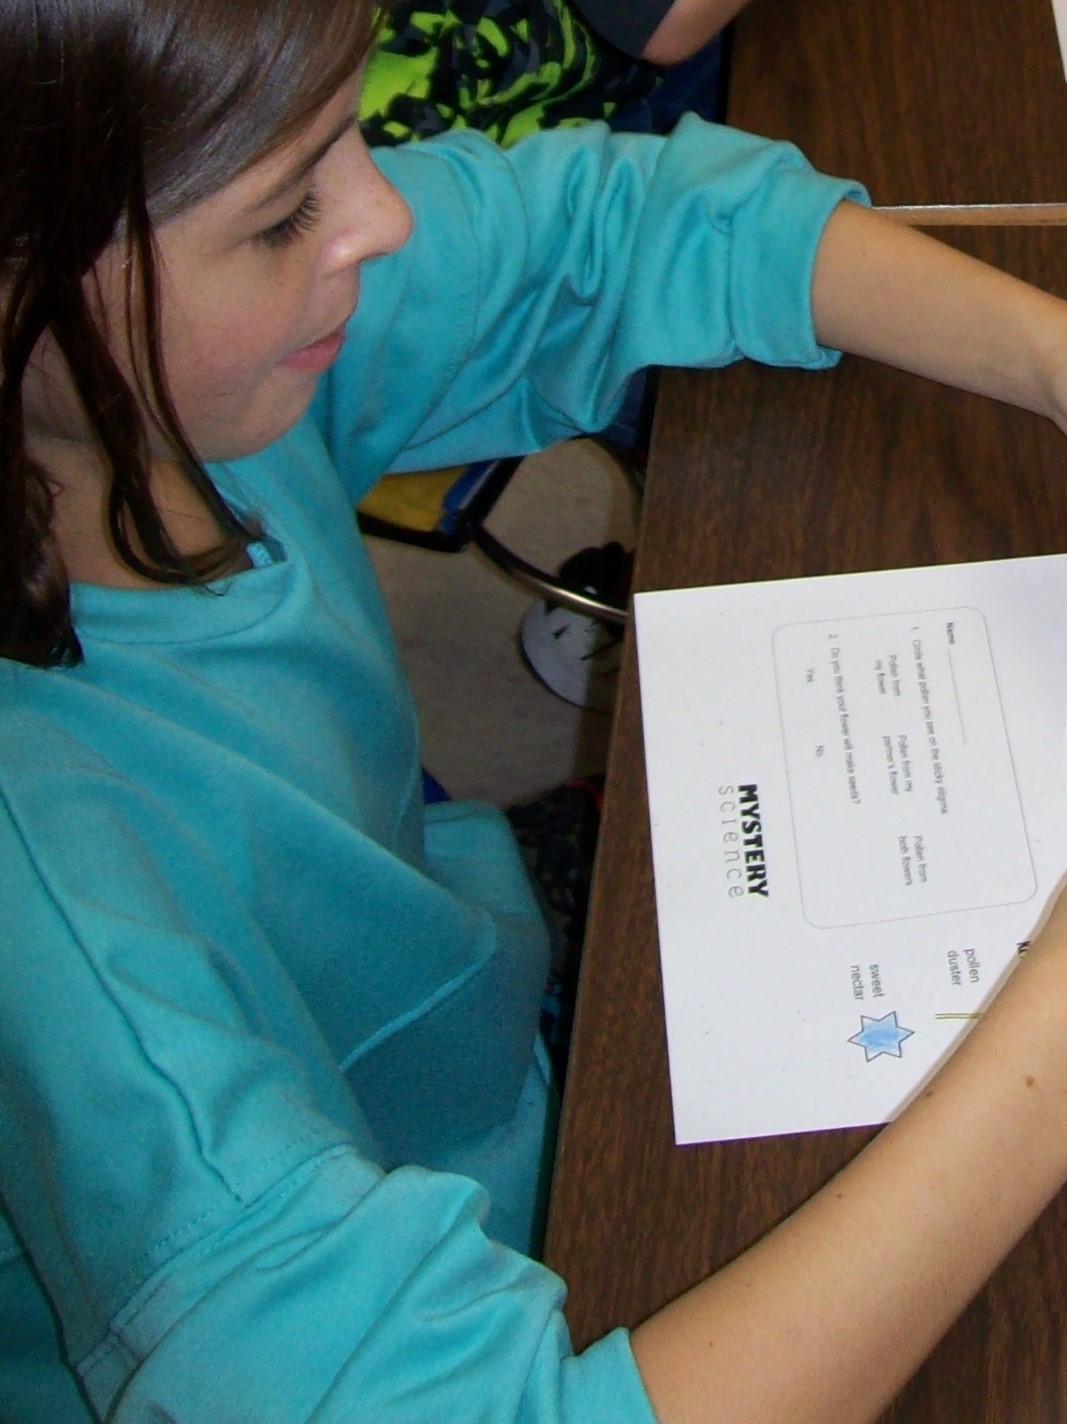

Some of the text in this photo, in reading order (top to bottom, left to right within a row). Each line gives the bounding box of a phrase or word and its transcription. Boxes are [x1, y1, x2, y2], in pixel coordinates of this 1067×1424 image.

[945, 622, 955, 644] Name
[831, 647, 840, 659] Do
[912, 639, 923, 661] Circle
[830, 659, 841, 675] you
[873, 660, 887, 695] my flower
[888, 655, 901, 697] Pollen from
[916, 661, 926, 680] what
[834, 675, 844, 694] think
[918, 681, 930, 704] pollen
[806, 667, 824, 758] Yes No
[836, 695, 847, 713] your
[922, 705, 931, 720] you
[840, 714, 849, 736] flower
[926, 721, 934, 735] see
[844, 737, 853, 751] will
[928, 736, 937, 747] on
[845, 751, 855, 775] make
[898, 735, 913, 793] Pollen from my
[931, 747, 940, 761] the
[888, 771, 899, 795] flower
[933, 762, 944, 784] sticky
[738, 784, 769, 898] MYSTERY
[898, 835, 912, 886] both flowers
[913, 835, 927, 883] Pollen from
[947, 950, 962, 987] duster
[963, 948, 980, 983] pollen
[850, 965, 864, 1001] nectar
[869, 964, 884, 998] sweet
